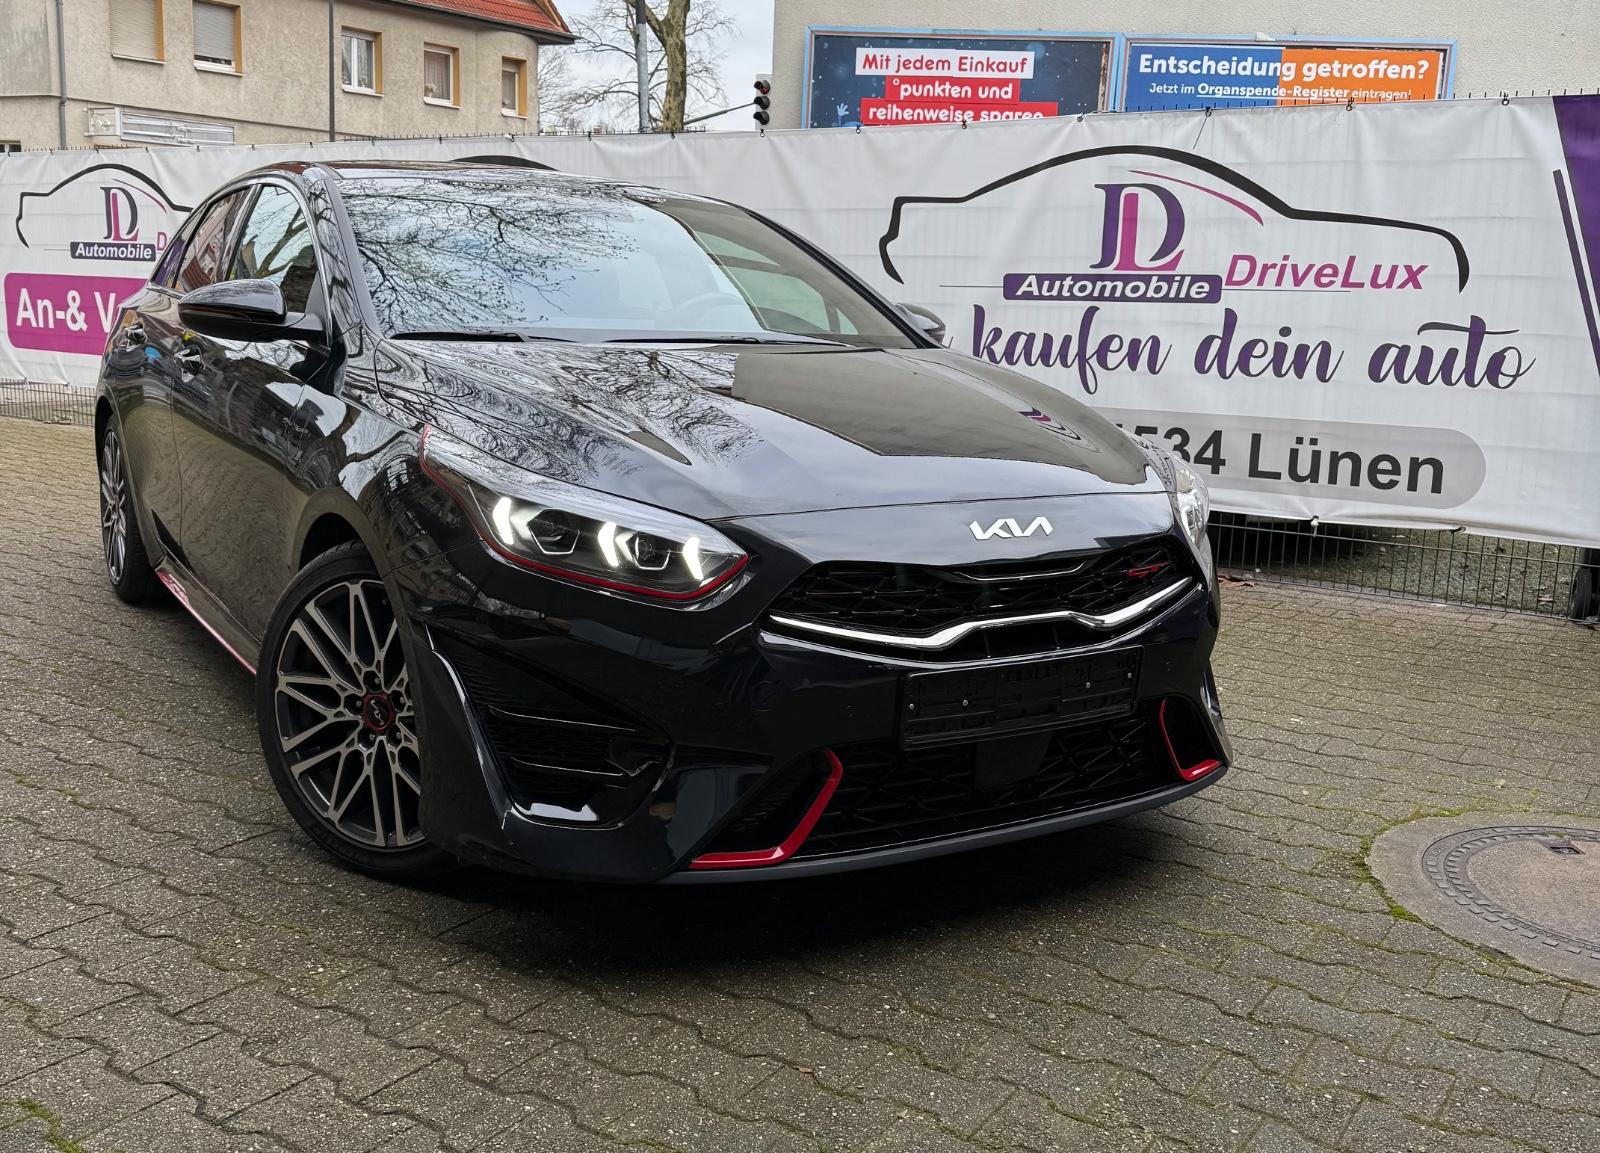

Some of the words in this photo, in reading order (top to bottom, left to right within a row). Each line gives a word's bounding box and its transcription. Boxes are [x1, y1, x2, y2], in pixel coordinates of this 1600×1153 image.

[862, 54, 891, 70] Mit
[895, 54, 951, 73] jedem
[958, 56, 1028, 73] Einkauf
[1139, 53, 1297, 82] Entscheidung
[1302, 59, 1430, 82] getroffen?
[978, 83, 1013, 99] und
[1149, 83, 1178, 94] Jetzt
[1180, 84, 1195, 94] im
[1197, 83, 1350, 100] Organspende-Register
[1352, 88, 1412, 101] eintragen!
[869, 103, 975, 122] reihenweise
[75, 243, 152, 260] Automobile
[1015, 275, 1210, 300] Automobile
[1225, 254, 1430, 291] DriveLux
[973, 304, 1173, 395] kaufen
[1194, 308, 1345, 384] dein
[1368, 315, 1537, 389] auto
[1248, 432, 1445, 494] Lünen
[969, 516, 1053, 540] KIA
